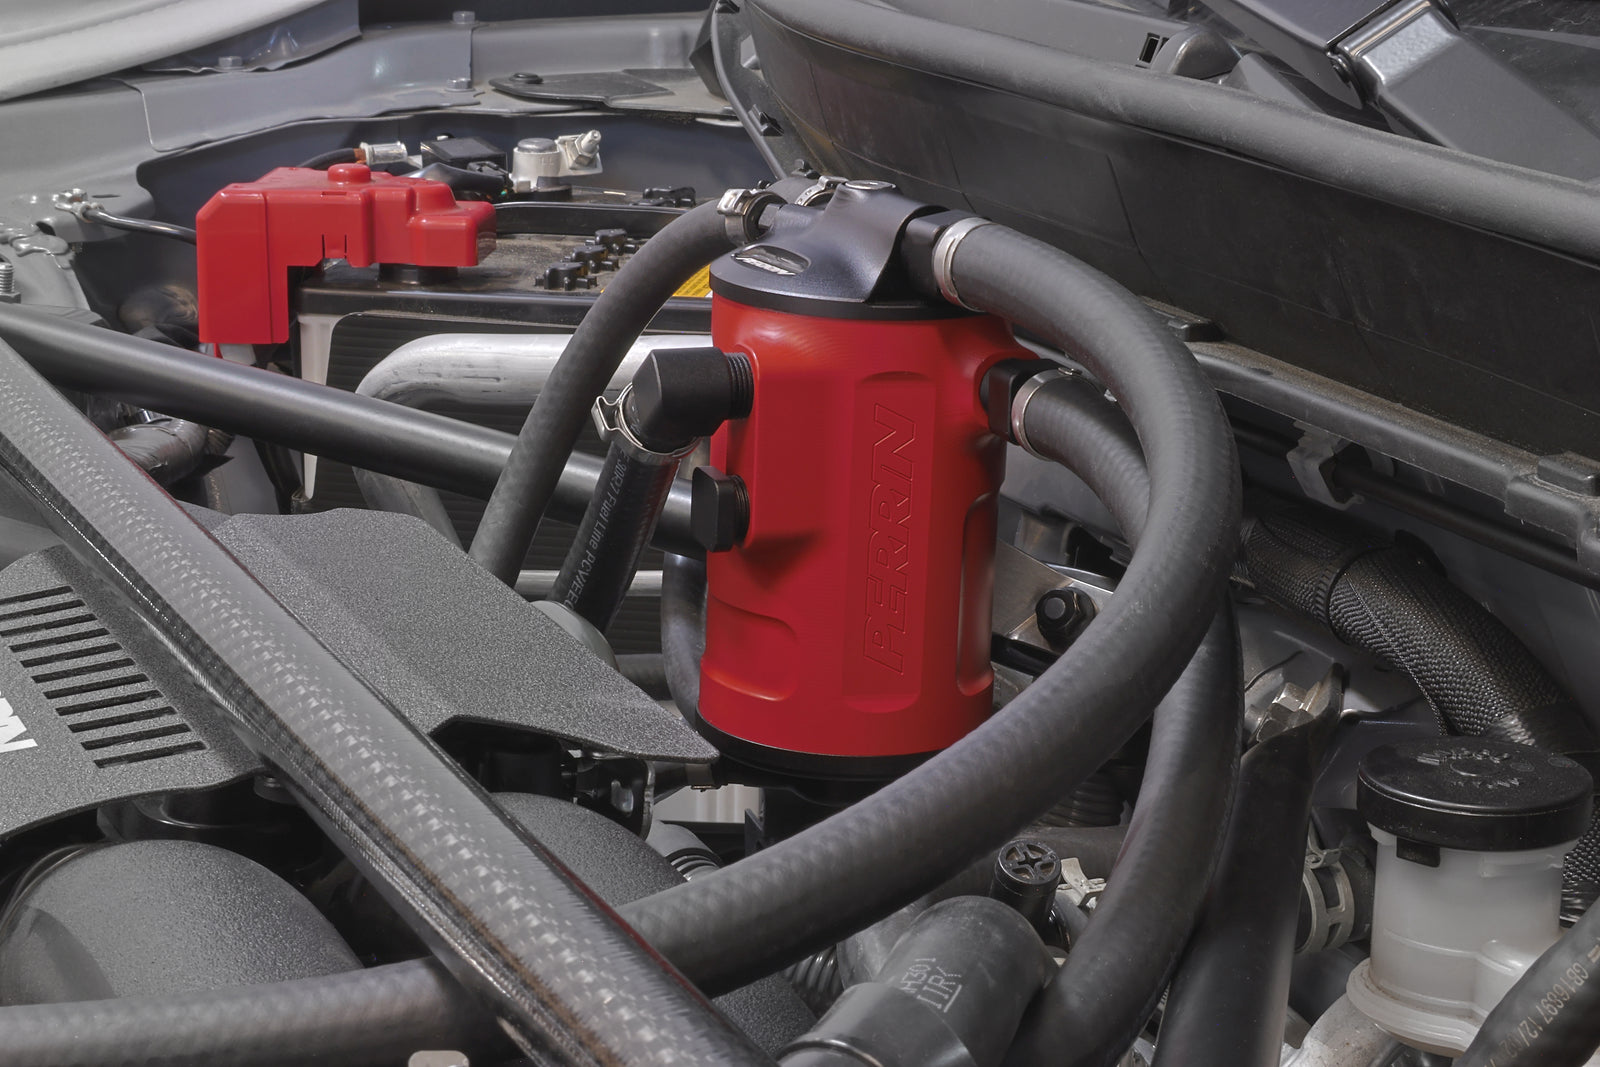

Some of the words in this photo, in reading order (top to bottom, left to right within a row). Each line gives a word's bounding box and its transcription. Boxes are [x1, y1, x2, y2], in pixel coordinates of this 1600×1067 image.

[599, 491, 617, 523] Fuel
[589, 519, 607, 550] Line
[863, 402, 917, 675] PERRIN
[1535, 962, 1590, 1025] GB16897
